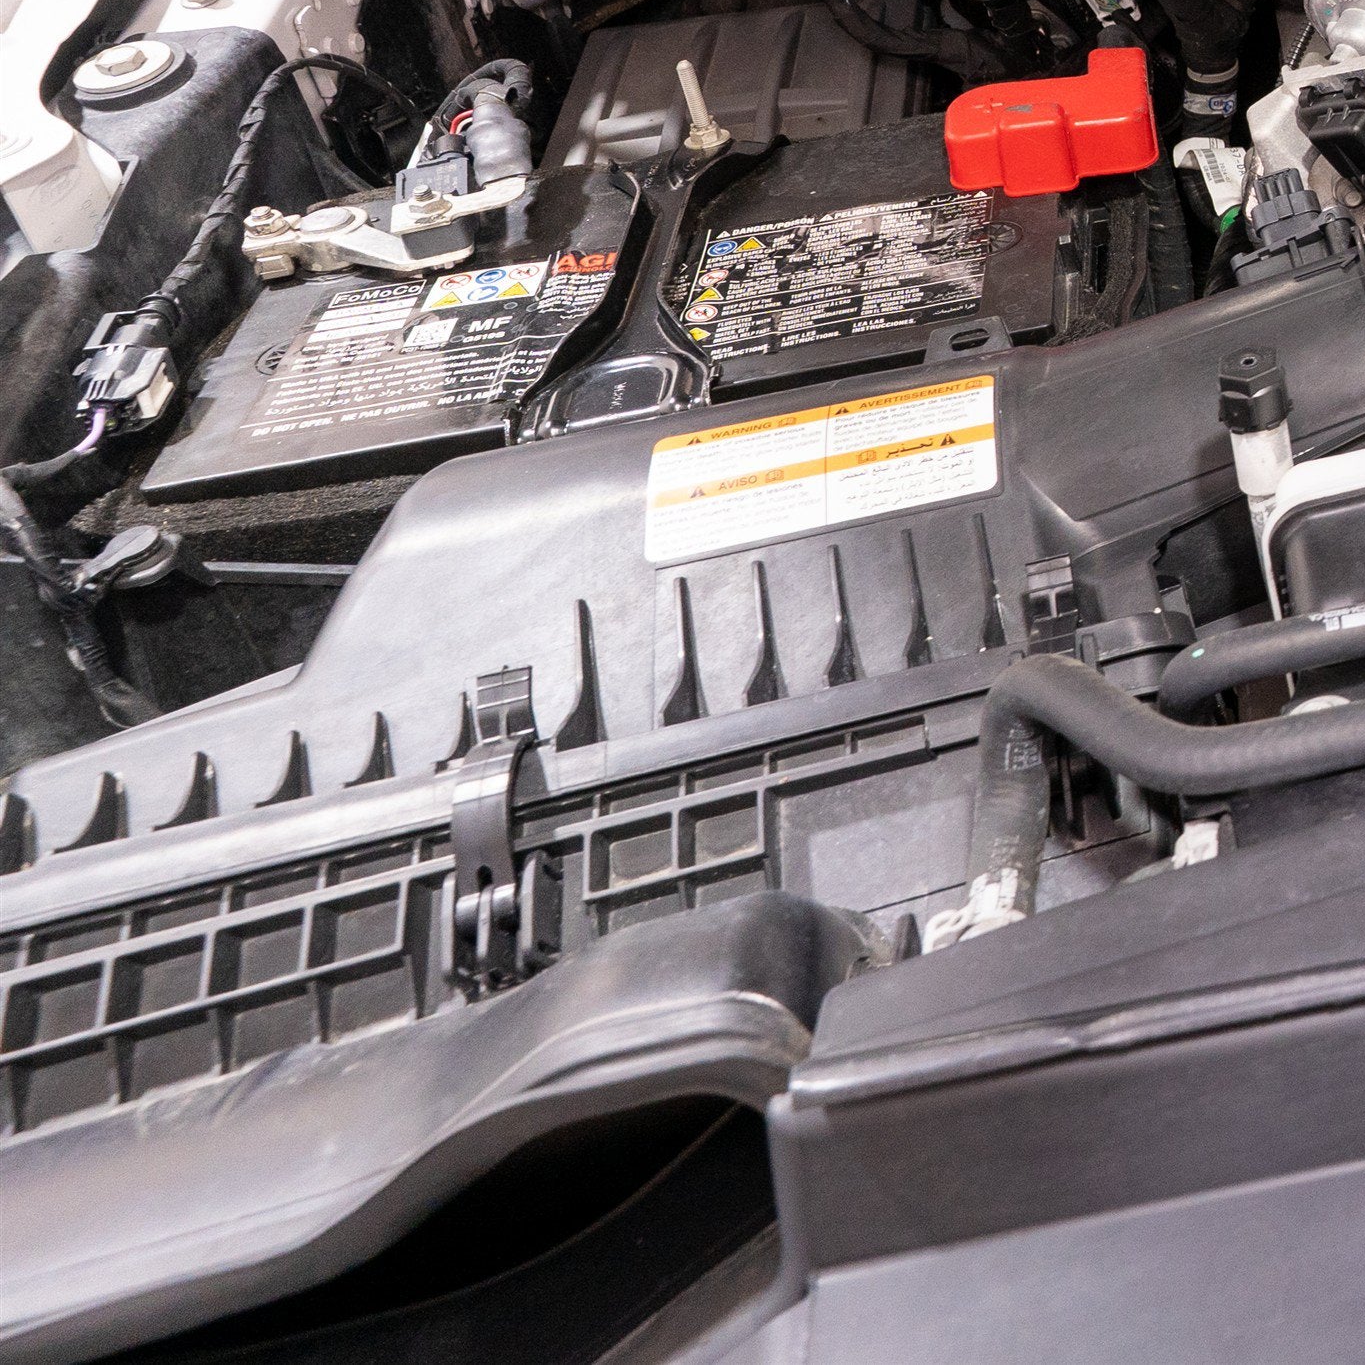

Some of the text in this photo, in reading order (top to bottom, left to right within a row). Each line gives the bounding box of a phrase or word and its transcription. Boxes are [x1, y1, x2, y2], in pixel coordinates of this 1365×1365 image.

[835, 202, 918, 219] PELIGRO/VENENO
[732, 218, 814, 235] DANGER/POISON
[334, 283, 421, 305] FoMoCo
[468, 316, 512, 333] MF
[852, 319, 914, 333] INSTRUCCIONES.
[781, 331, 840, 347] INSTRUCTIONS.
[712, 344, 769, 360] NSTRUCTIONS.
[860, 384, 960, 409] AVERTISSEMENT
[384, 401, 430, 415] OUVRIR.
[712, 422, 772, 439] WARNING
[719, 475, 758, 491] AVISO
